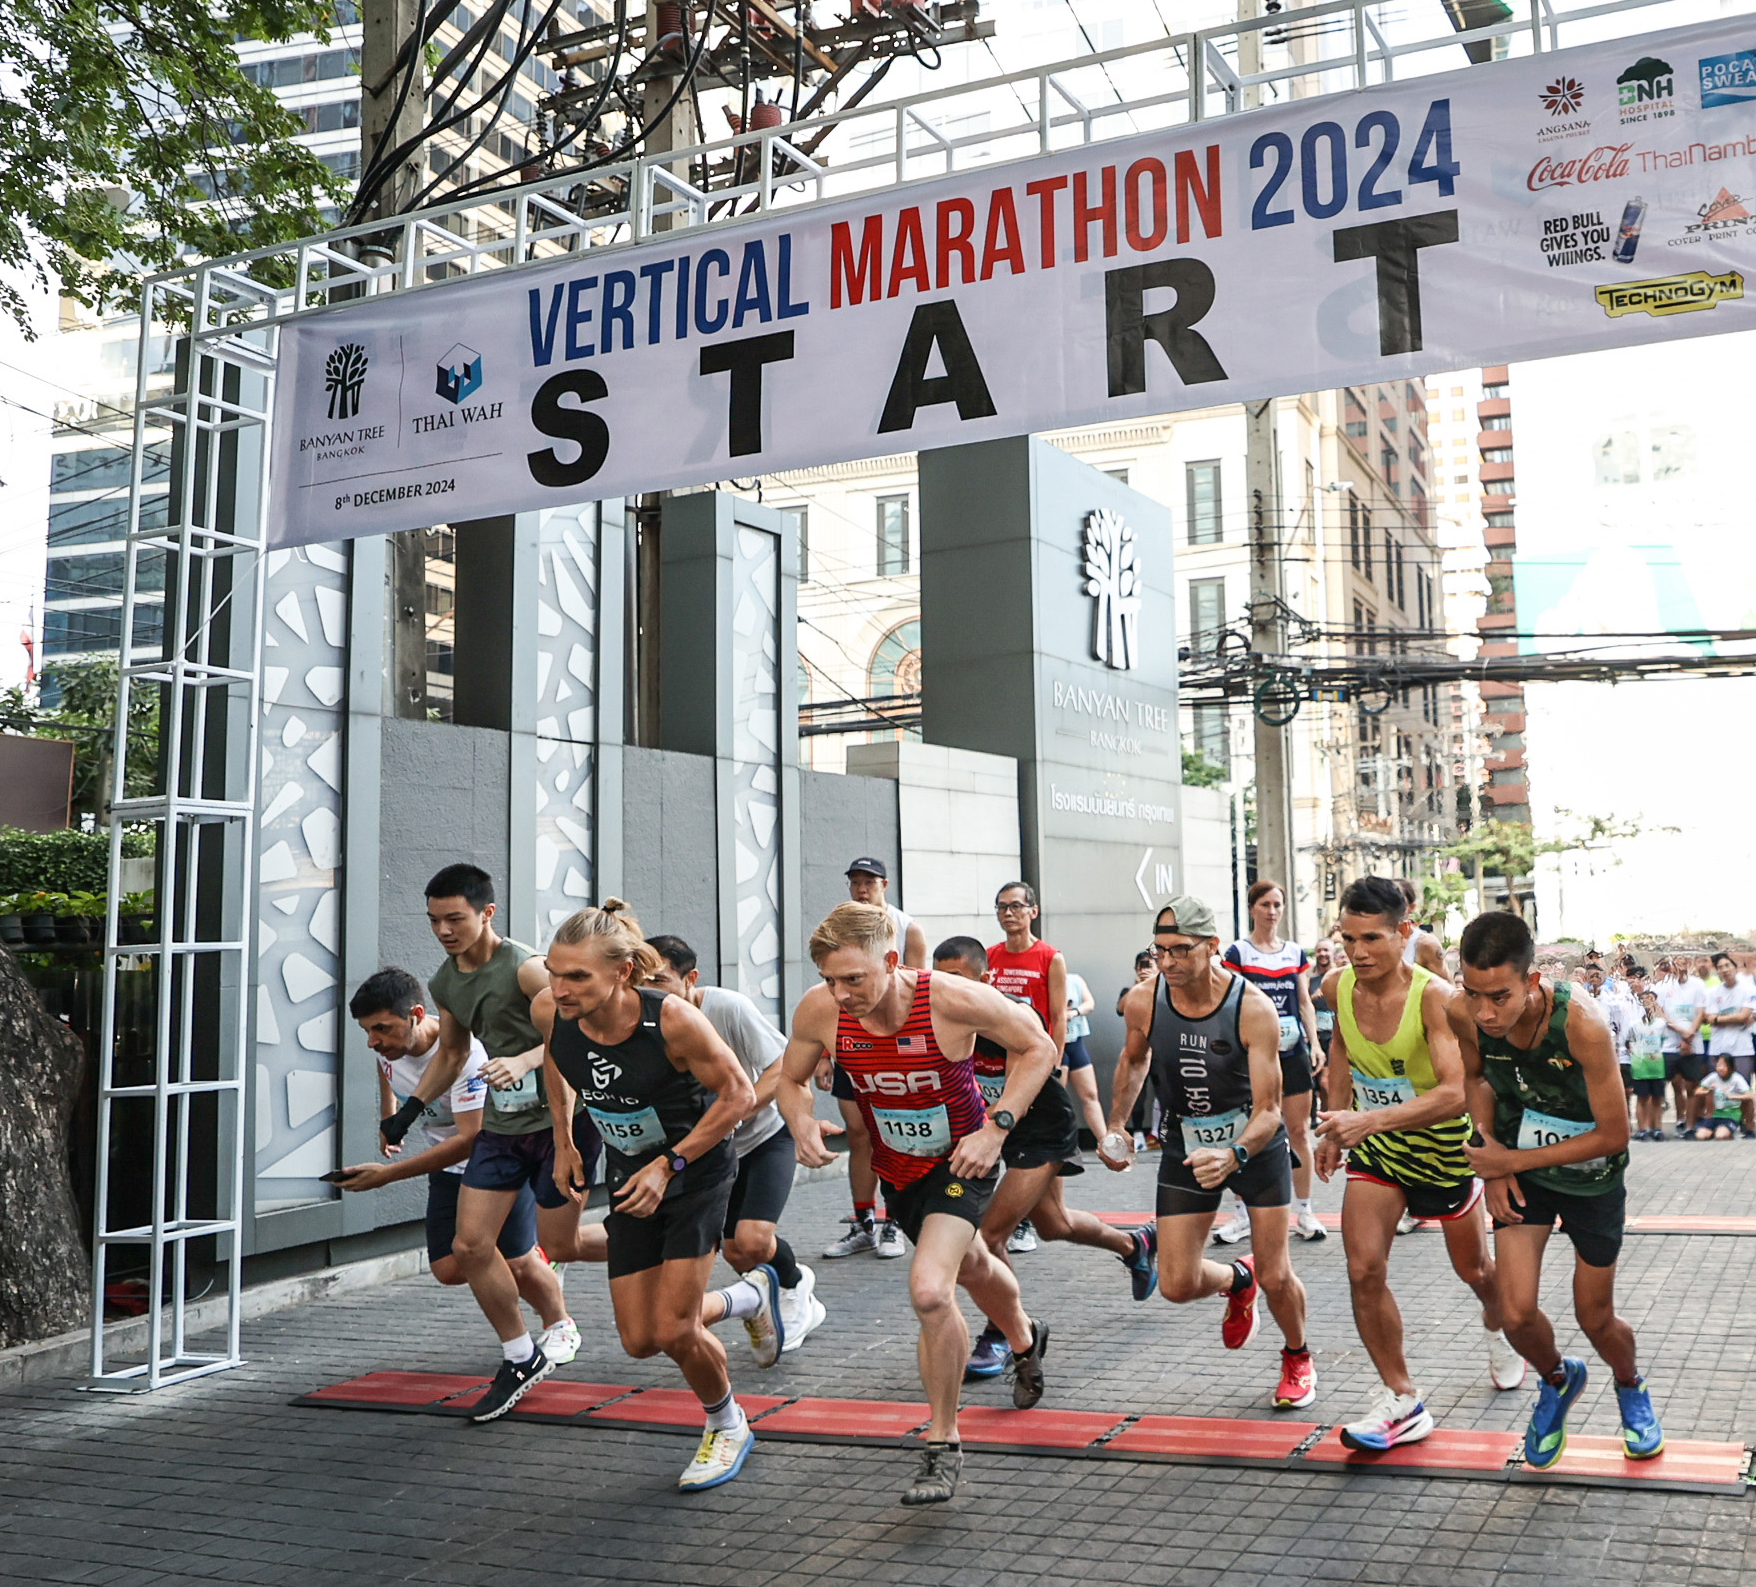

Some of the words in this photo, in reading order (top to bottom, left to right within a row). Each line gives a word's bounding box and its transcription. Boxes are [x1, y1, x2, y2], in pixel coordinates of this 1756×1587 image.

[1702, 59, 1754, 78] POCA
[1618, 78, 1673, 103] BNH
[1619, 101, 1674, 116] HOSPITAL
[1620, 114, 1647, 125] SINCE
[1653, 110, 1675, 119] 1898
[1537, 120, 1591, 136] ANGSANA
[1527, 141, 1636, 191] Coca-Cola
[529, 234, 809, 366] VERTICAL
[830, 144, 1222, 309] MARATHON
[1249, 98, 1460, 230] 2024
[1544, 219, 1569, 235] RED
[1572, 211, 1603, 229] BULL
[1540, 233, 1578, 252] GIVES
[1582, 227, 1610, 245] YOU
[1668, 235, 1701, 247] COVER
[1709, 230, 1738, 241] PRINT
[413, 411, 454, 434] THAI
[461, 402, 503, 424] WAH
[300, 430, 354, 452] BANYAN
[358, 425, 385, 441] TREE
[317, 446, 365, 461] BANGKOK
[335, 493, 350, 510] 8th
[354, 485, 422, 507] DECEMBER
[426, 479, 455, 496] 2024
[1053, 680, 1129, 723] BANYAN
[1135, 701, 1168, 732] TREE
[1090, 730, 1142, 756] BANGKOK
[1155, 864, 1173, 895] IN
[996, 976, 1028, 986] ASSOCIATION
[1180, 1033, 1207, 1049] RUN
[846, 1070, 941, 1096] USA
[1362, 1086, 1403, 1106] 1354
[598, 1120, 644, 1138] 1158
[884, 1121, 932, 1138] 1138
[1194, 1122, 1235, 1144] 1327
